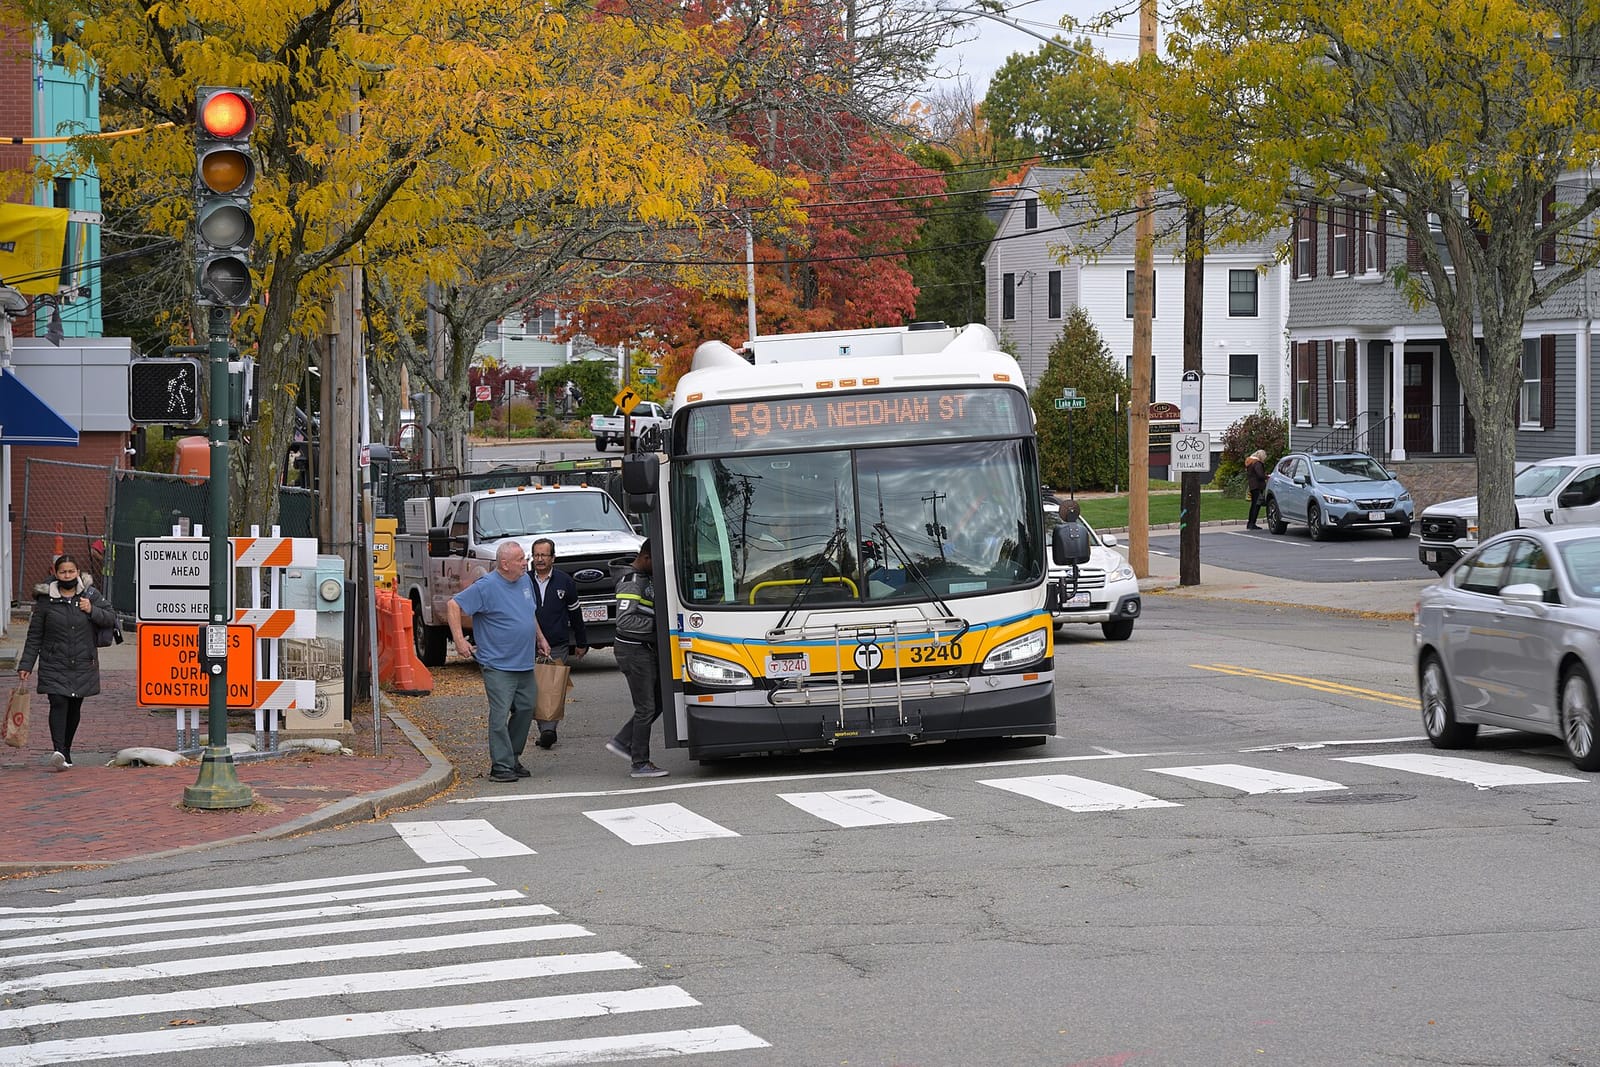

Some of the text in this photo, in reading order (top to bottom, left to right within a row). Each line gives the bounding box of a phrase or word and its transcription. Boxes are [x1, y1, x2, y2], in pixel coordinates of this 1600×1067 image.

[1059, 399, 1083, 408] Lake Ave
[729, 394, 967, 437] 59 VIA NEEDHAM ST
[373, 543, 389, 551] ERE
[144, 550, 209, 561] SIDEWALK CLO
[171, 566, 200, 576] AHEAD
[156, 603, 209, 614] CROSS HER
[153, 633, 240, 648] BUSINS
[179, 650, 201, 663] OP
[910, 643, 962, 663] 3240
[782, 659, 807, 672] 3240
[171, 666, 207, 680] DURI
[145, 682, 248, 697] CONSTRUION
